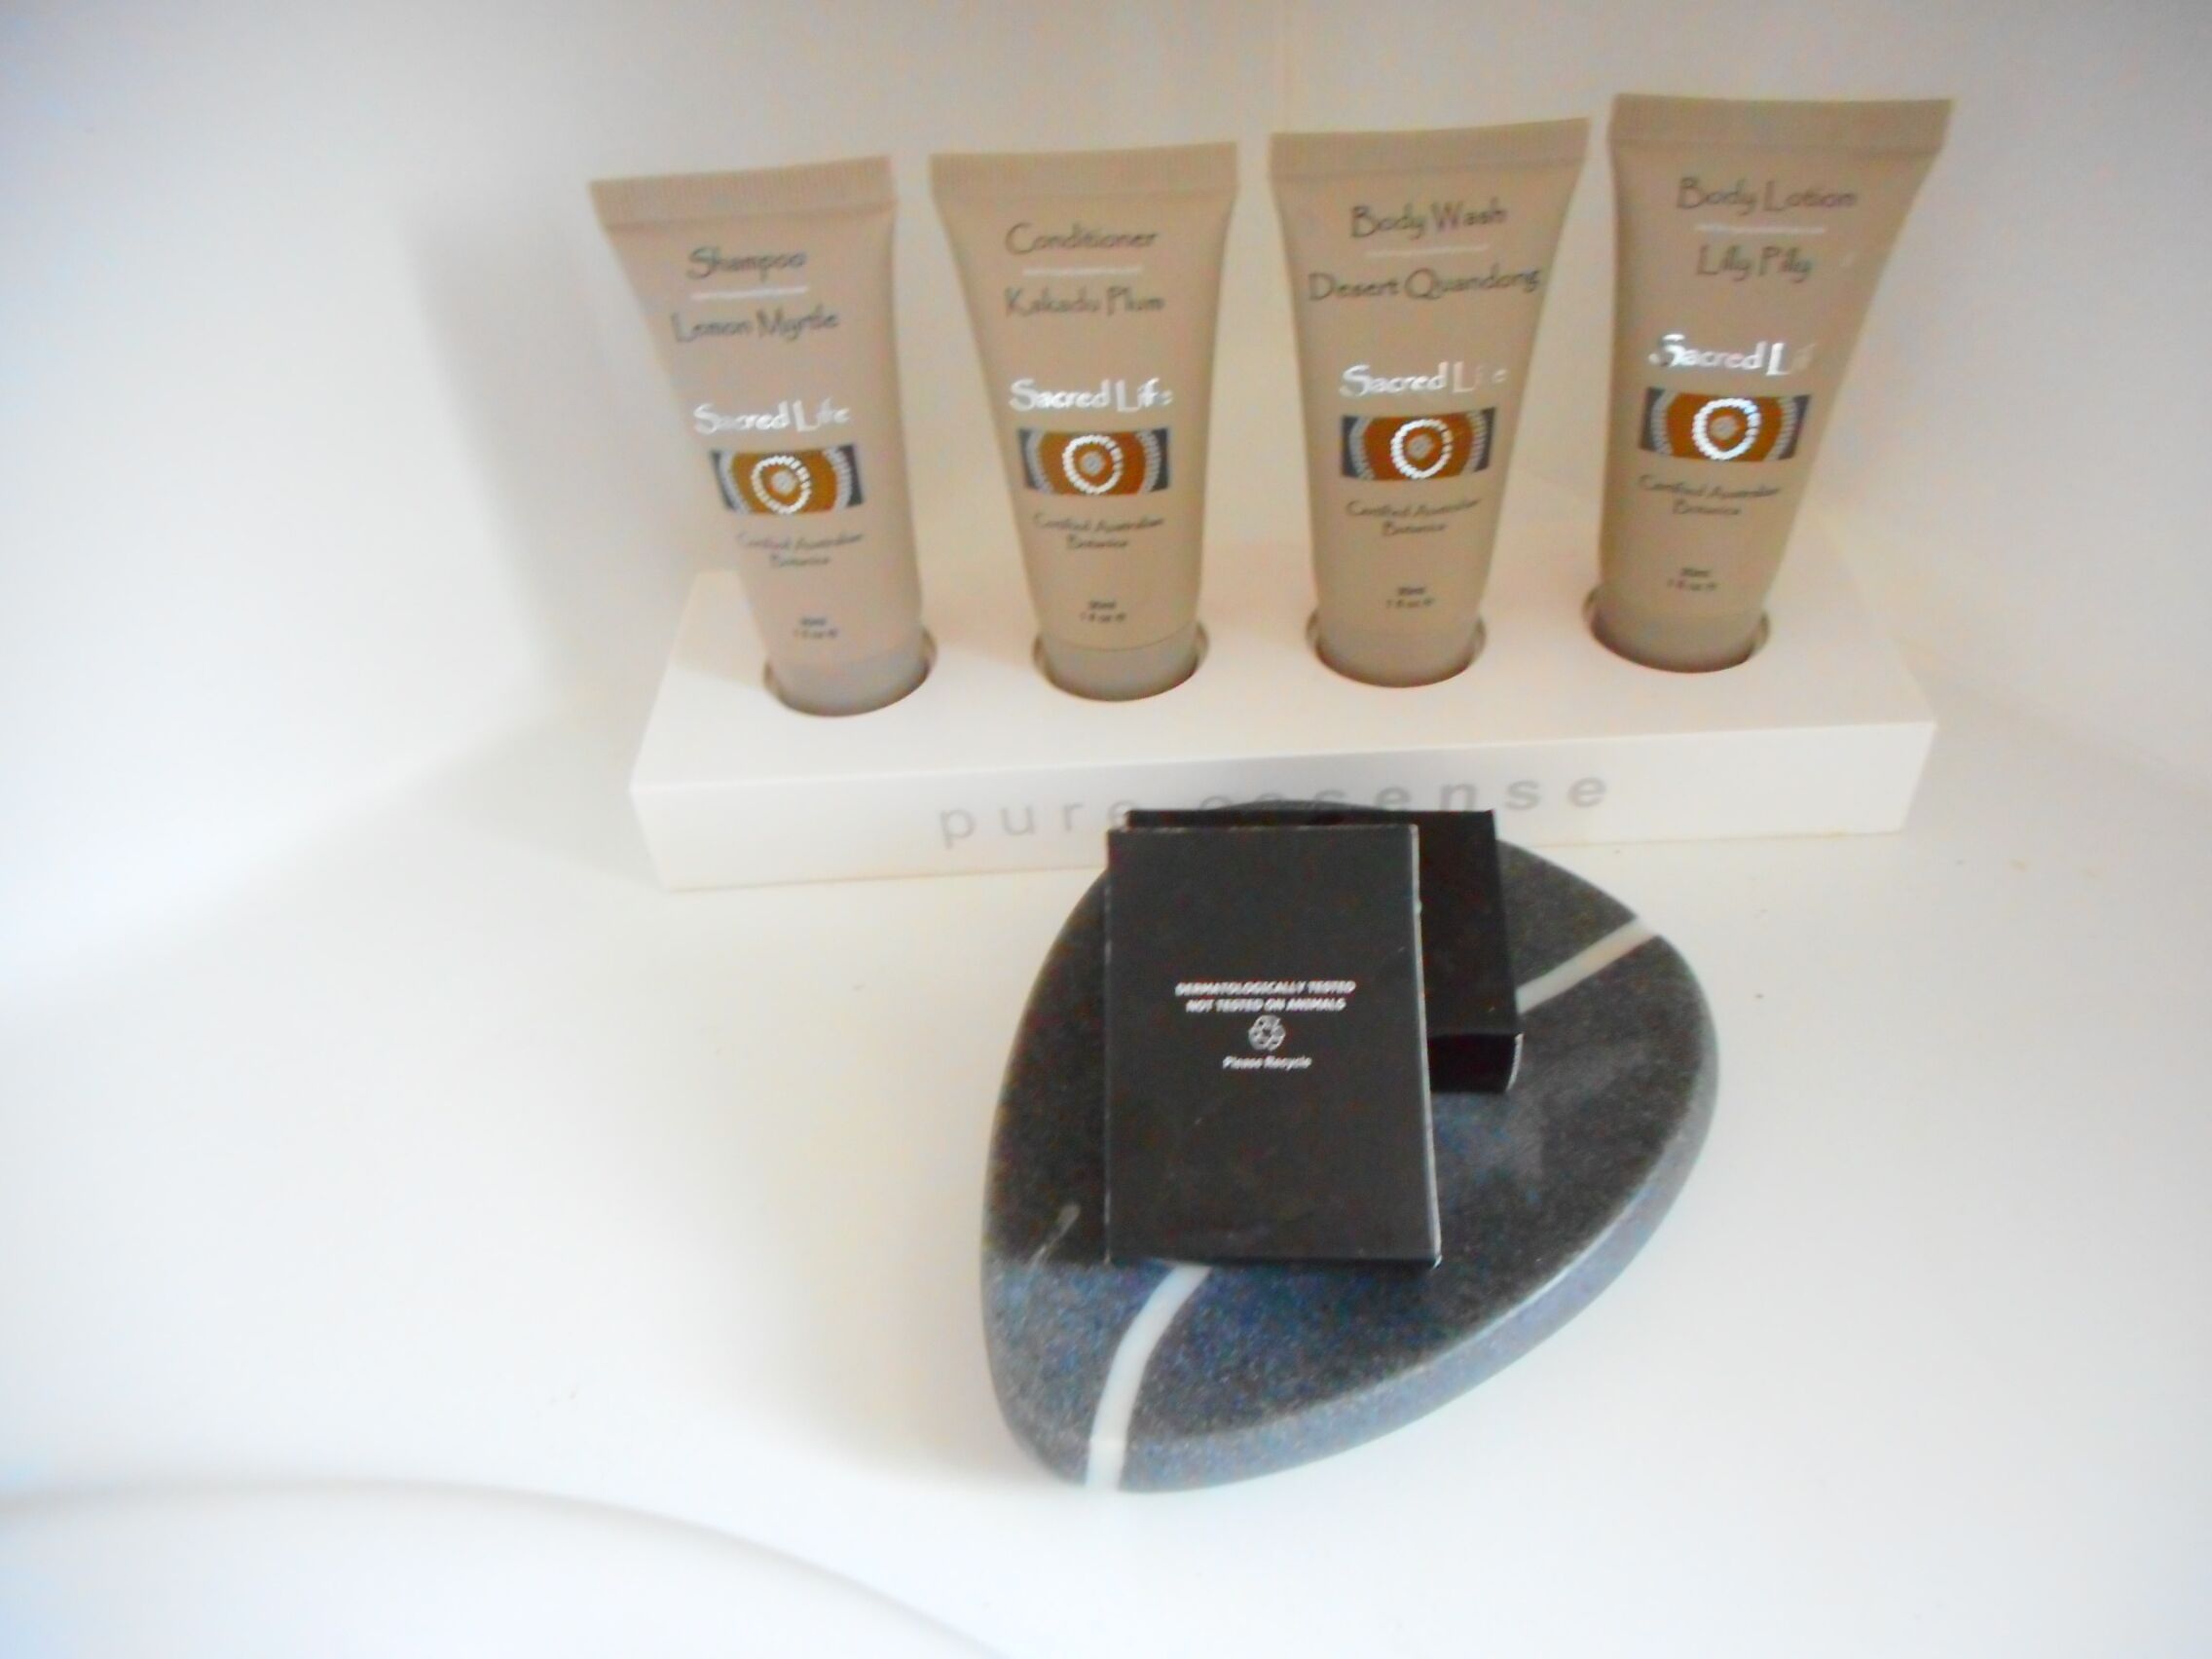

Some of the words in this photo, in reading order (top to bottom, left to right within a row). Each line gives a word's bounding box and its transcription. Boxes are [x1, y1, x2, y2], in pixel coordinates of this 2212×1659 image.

[1677, 176, 1757, 215] Body
[1762, 179, 1858, 211] Lotion
[1350, 203, 1425, 240] Body
[1430, 197, 1507, 233] Wash
[1005, 222, 1160, 255] Conditioner
[686, 245, 807, 281] Shampoo
[1004, 286, 1102, 316] Kakadu
[1107, 285, 1165, 316] Plum
[1308, 273, 1399, 301] Desert
[1405, 263, 1540, 301] Quandong
[670, 311, 751, 343] Lemon
[756, 303, 839, 342] Myrtle
[1648, 333, 1766, 370] Sacred
[1009, 377, 1111, 413] Sacred
[1339, 361, 1449, 398] Sacred
[692, 400, 790, 435] Sacred
[793, 397, 851, 433] Life
[939, 799, 1138, 851] pure
[1174, 979, 1307, 997] DERMATOLOGICALLY
[1308, 979, 1357, 995] TESTED
[1185, 998, 1215, 1014] NOT
[1215, 998, 1265, 1014] TESTED
[1264, 997, 1286, 1013] ON
[1285, 997, 1347, 1013] ANIMALS
[1222, 1054, 1264, 1071] Please
[1264, 1053, 1312, 1072] Recycle
